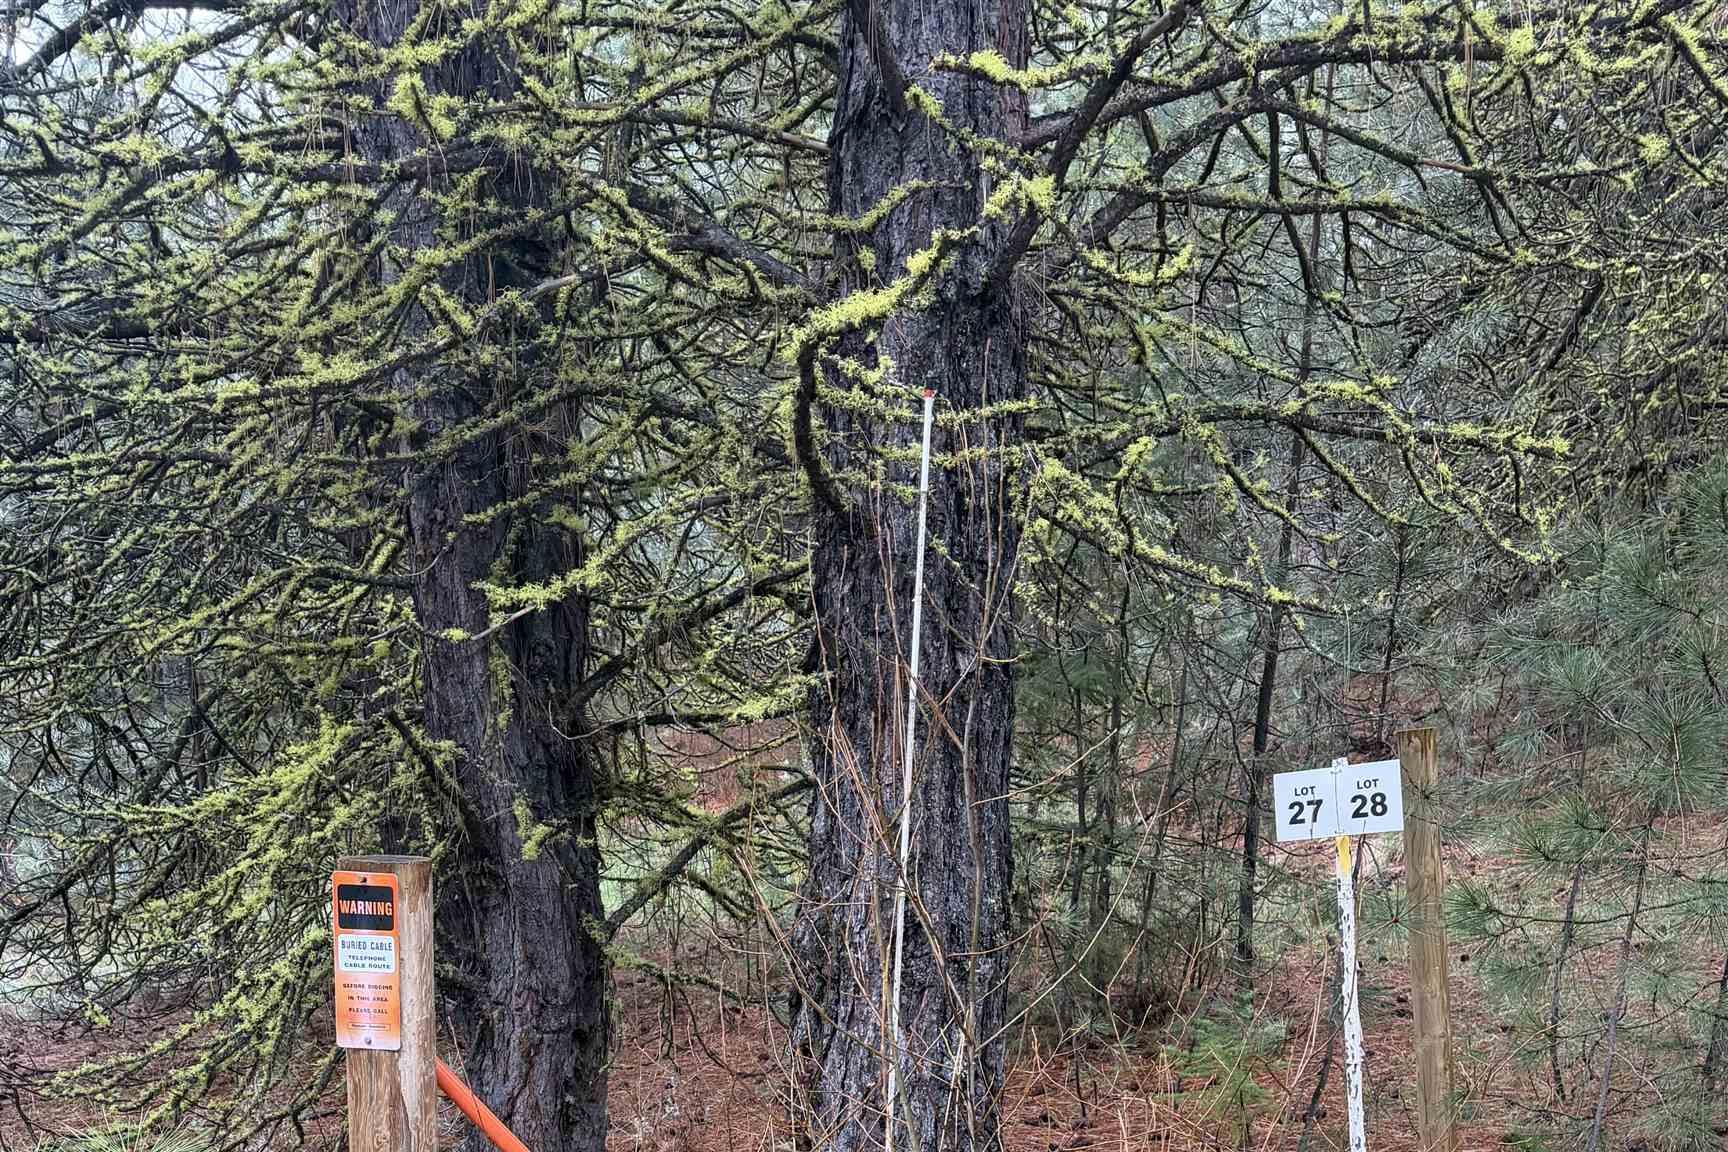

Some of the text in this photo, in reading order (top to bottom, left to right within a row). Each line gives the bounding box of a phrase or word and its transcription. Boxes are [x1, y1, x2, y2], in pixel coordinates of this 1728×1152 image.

[1356, 778, 1380, 790] LOT
[1294, 786, 1316, 797] LOT
[1288, 799, 1324, 825] 27
[1350, 792, 1388, 819] 28
[339, 900, 393, 916] WARNING
[341, 940, 393, 952] BURIED CABLE
